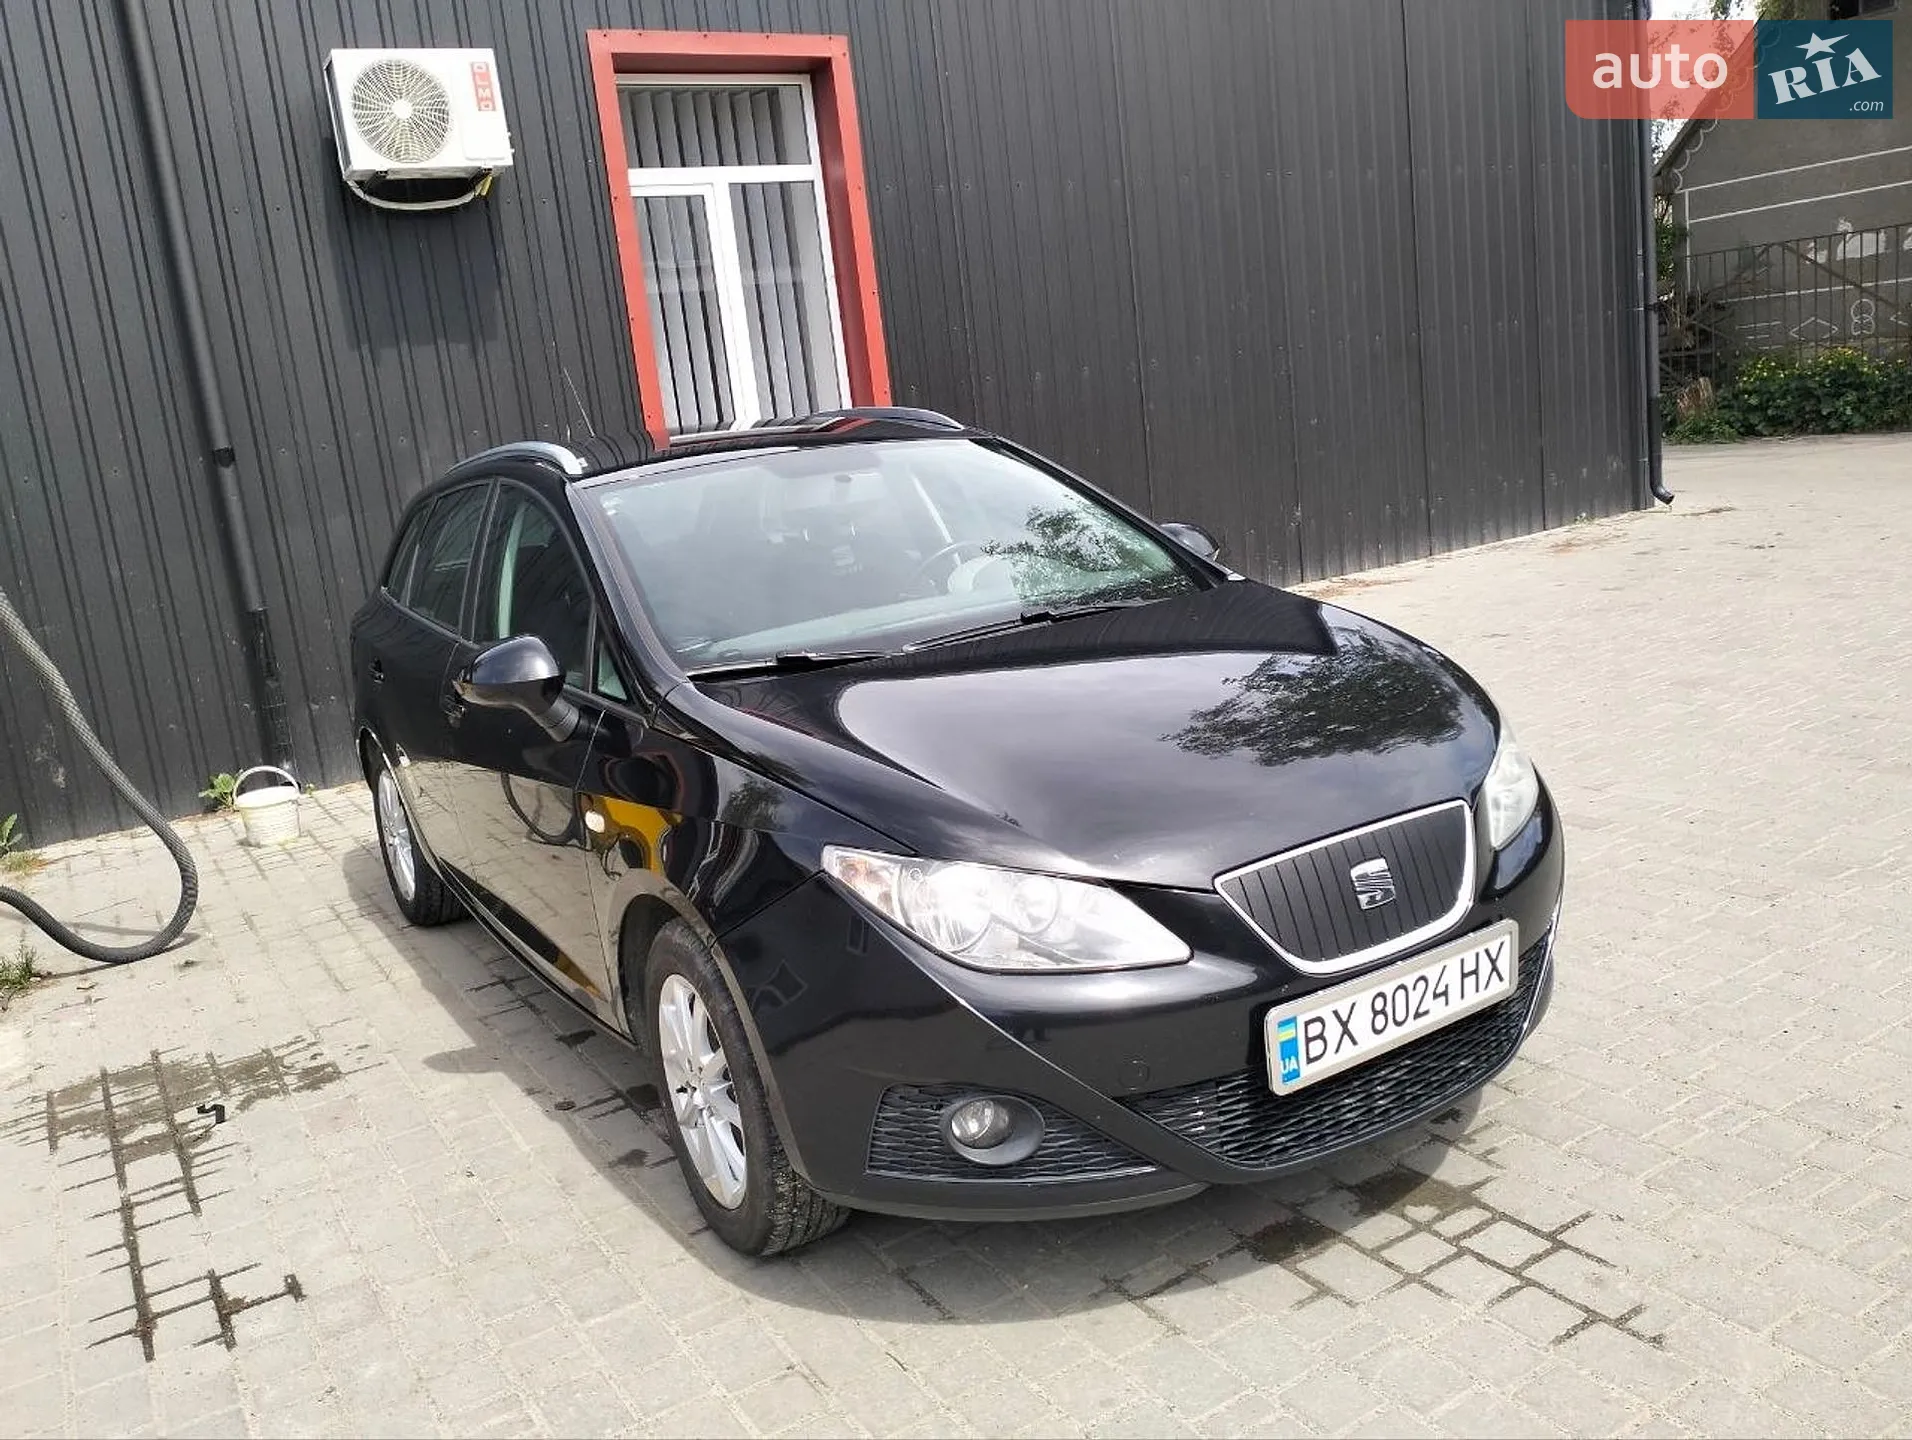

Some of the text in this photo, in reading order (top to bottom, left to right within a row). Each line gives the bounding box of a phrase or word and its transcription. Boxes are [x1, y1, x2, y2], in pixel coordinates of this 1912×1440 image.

[1304, 941, 1505, 1065] BX 8024 HX
[1280, 1056, 1298, 1074] UA
